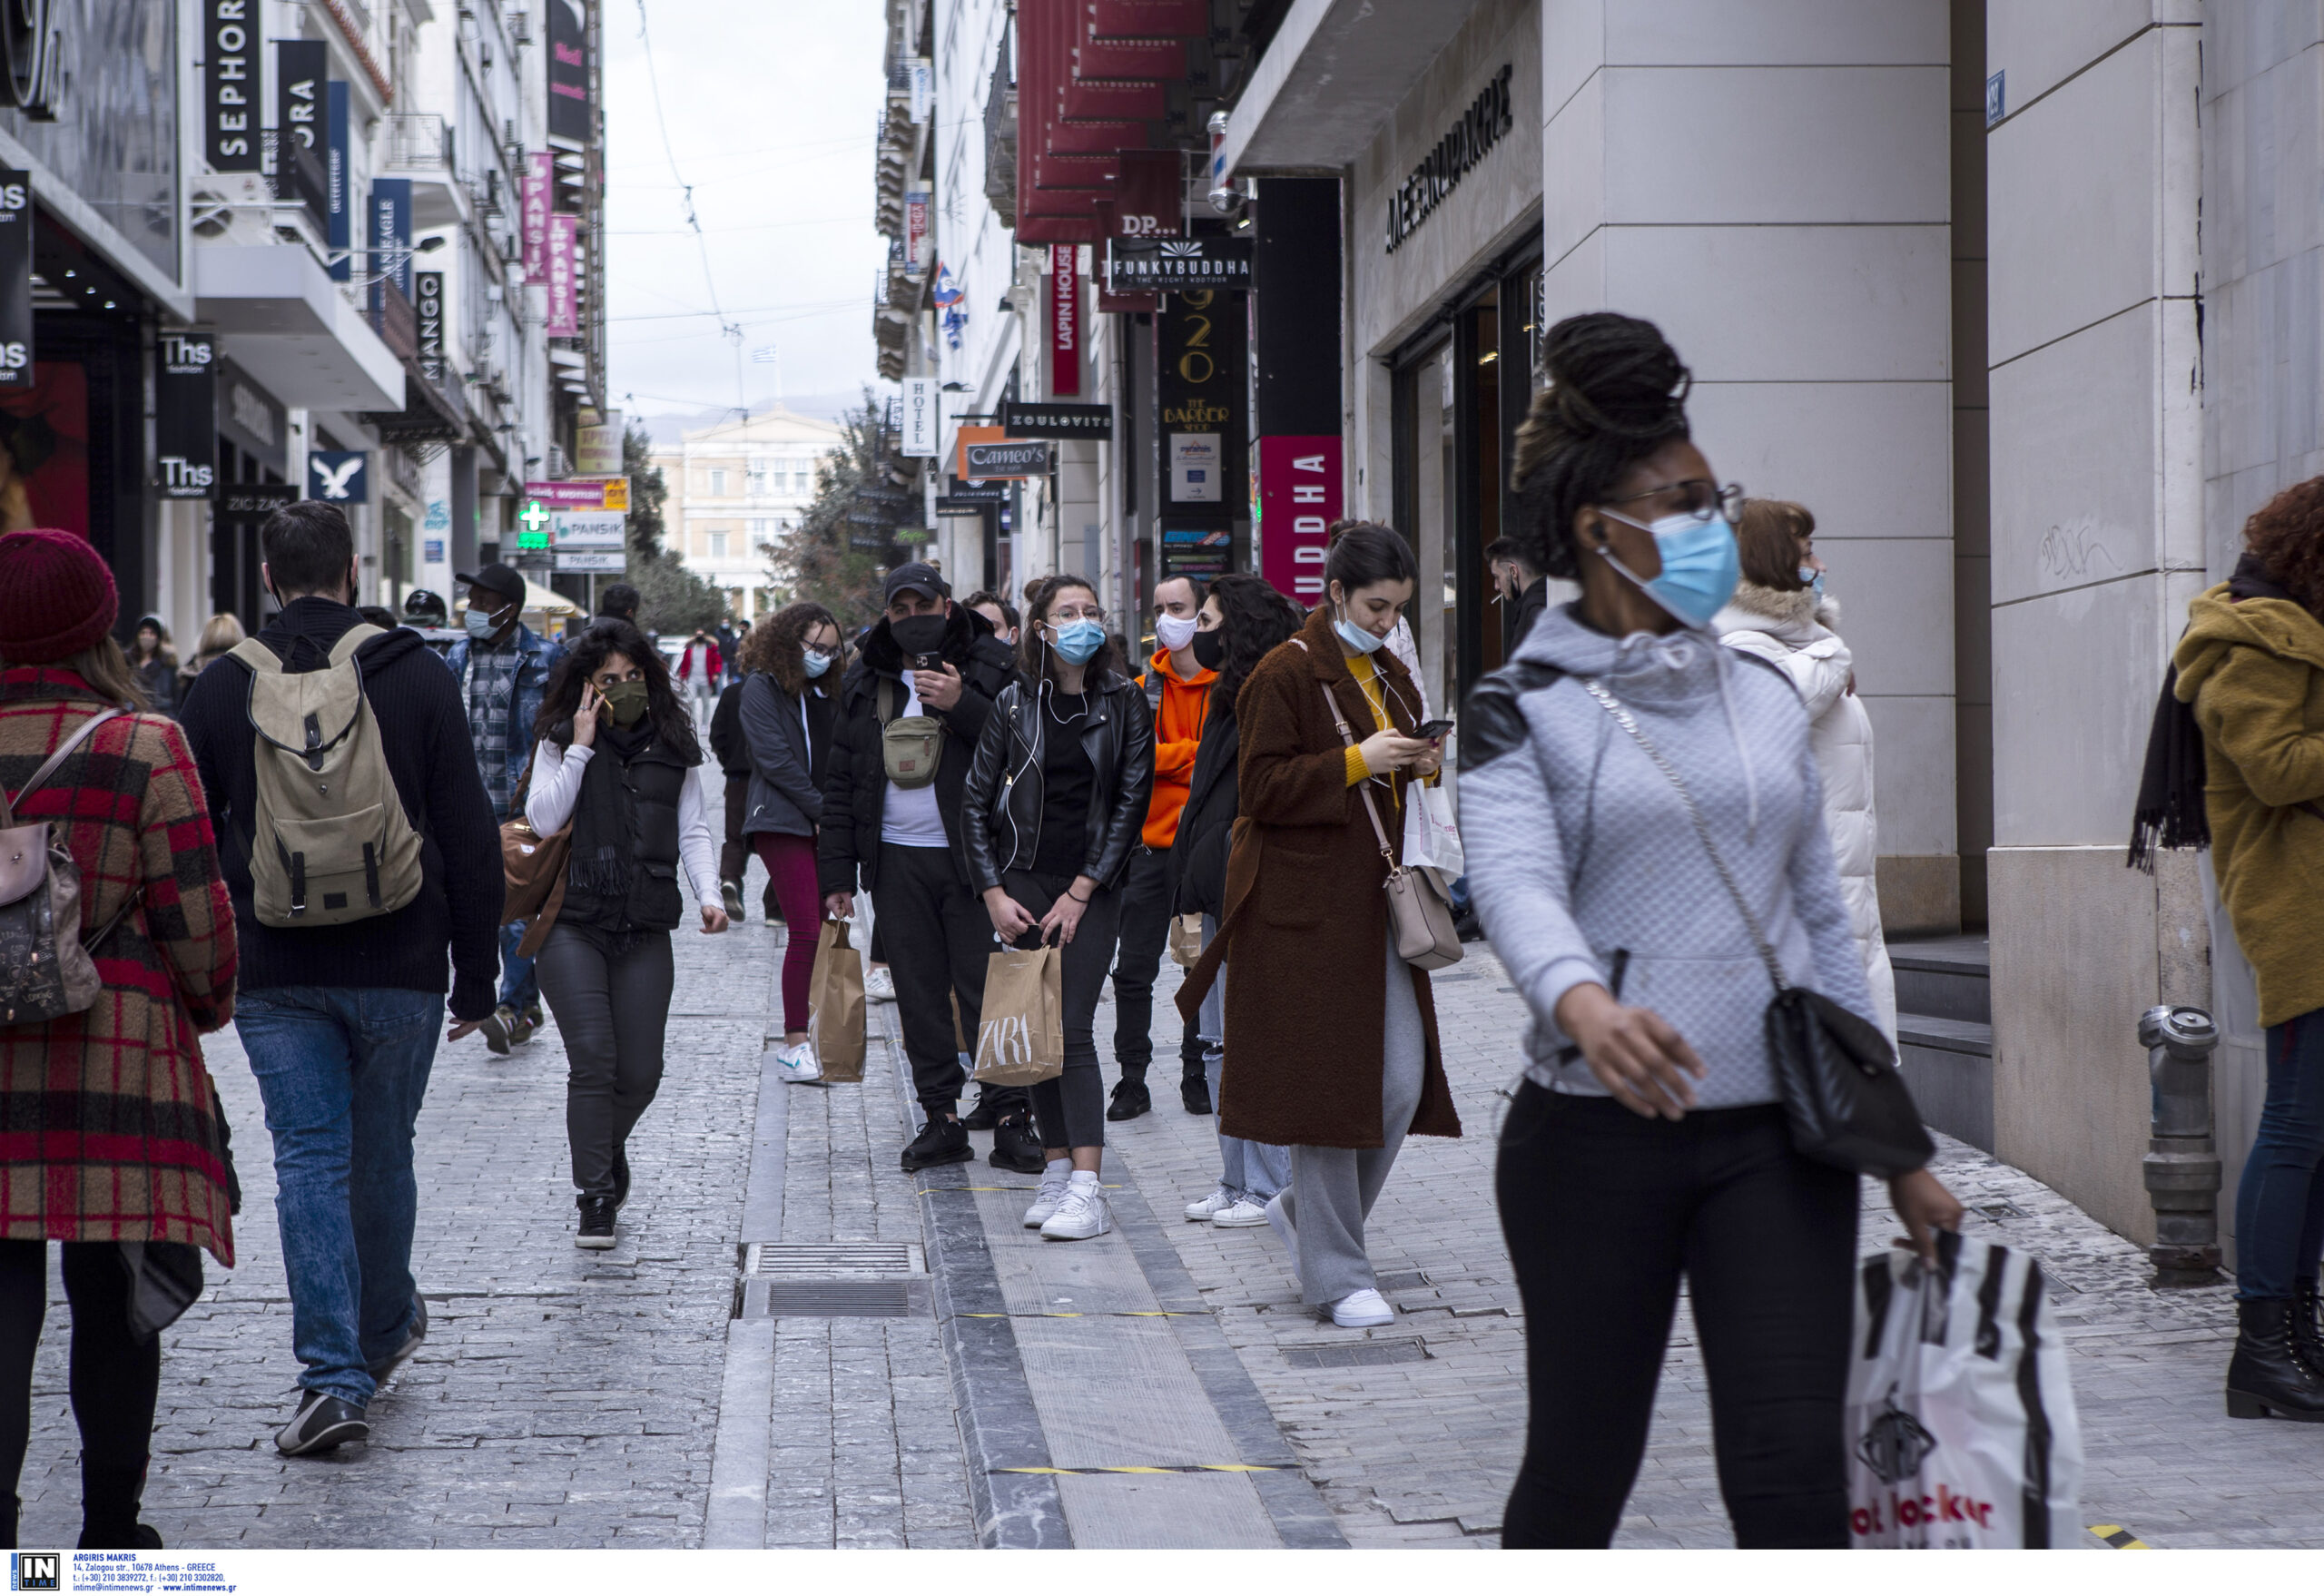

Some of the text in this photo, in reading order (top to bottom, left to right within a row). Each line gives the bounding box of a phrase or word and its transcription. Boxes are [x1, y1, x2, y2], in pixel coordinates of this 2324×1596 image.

[1114, 260, 1249, 275] FUNKYBUDDHA
[1058, 246, 1073, 350] LAPIN HOUSE
[159, 336, 212, 364] Ths
[913, 383, 925, 445] HOTEL
[1164, 407, 1229, 423] BARBER
[971, 447, 1045, 465] Cameo's
[159, 457, 213, 487] Ths
[226, 495, 255, 511] ZIC
[974, 1012, 1032, 1071] ZARA
